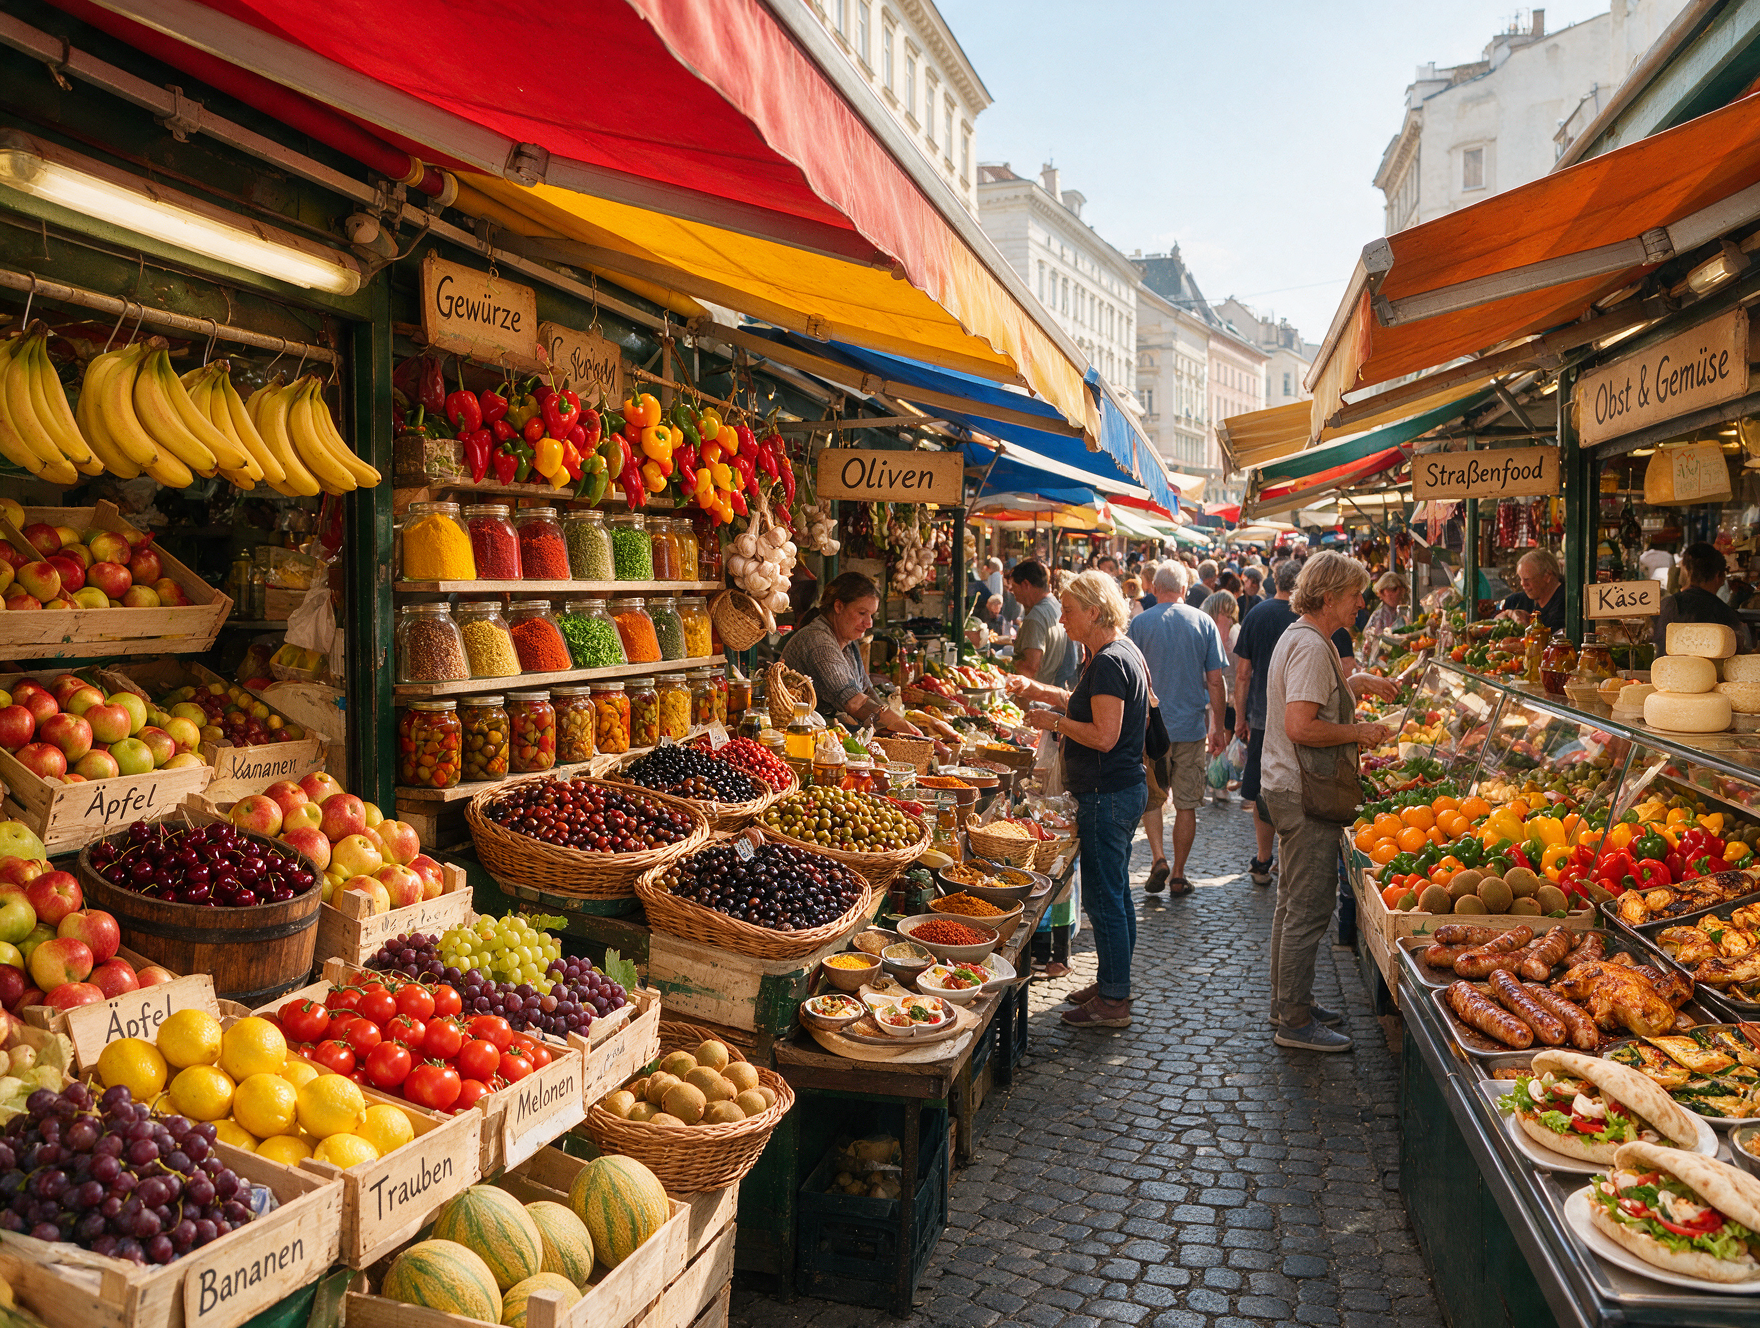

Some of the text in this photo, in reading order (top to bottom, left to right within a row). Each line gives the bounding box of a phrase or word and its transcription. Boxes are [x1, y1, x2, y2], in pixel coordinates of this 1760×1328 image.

[436, 275, 521, 333] Gewürze
[1595, 346, 1730, 425] Obst & Gemüse
[841, 457, 934, 489] Oliven
[1425, 455, 1544, 489] Straßenfood
[1598, 586, 1652, 610] Käse
[84, 783, 157, 825] Äpfel
[105, 993, 172, 1044] Äpfel
[516, 1075, 574, 1125] Melonen
[369, 1156, 453, 1221] Trauben
[198, 1238, 304, 1317] Bananen
